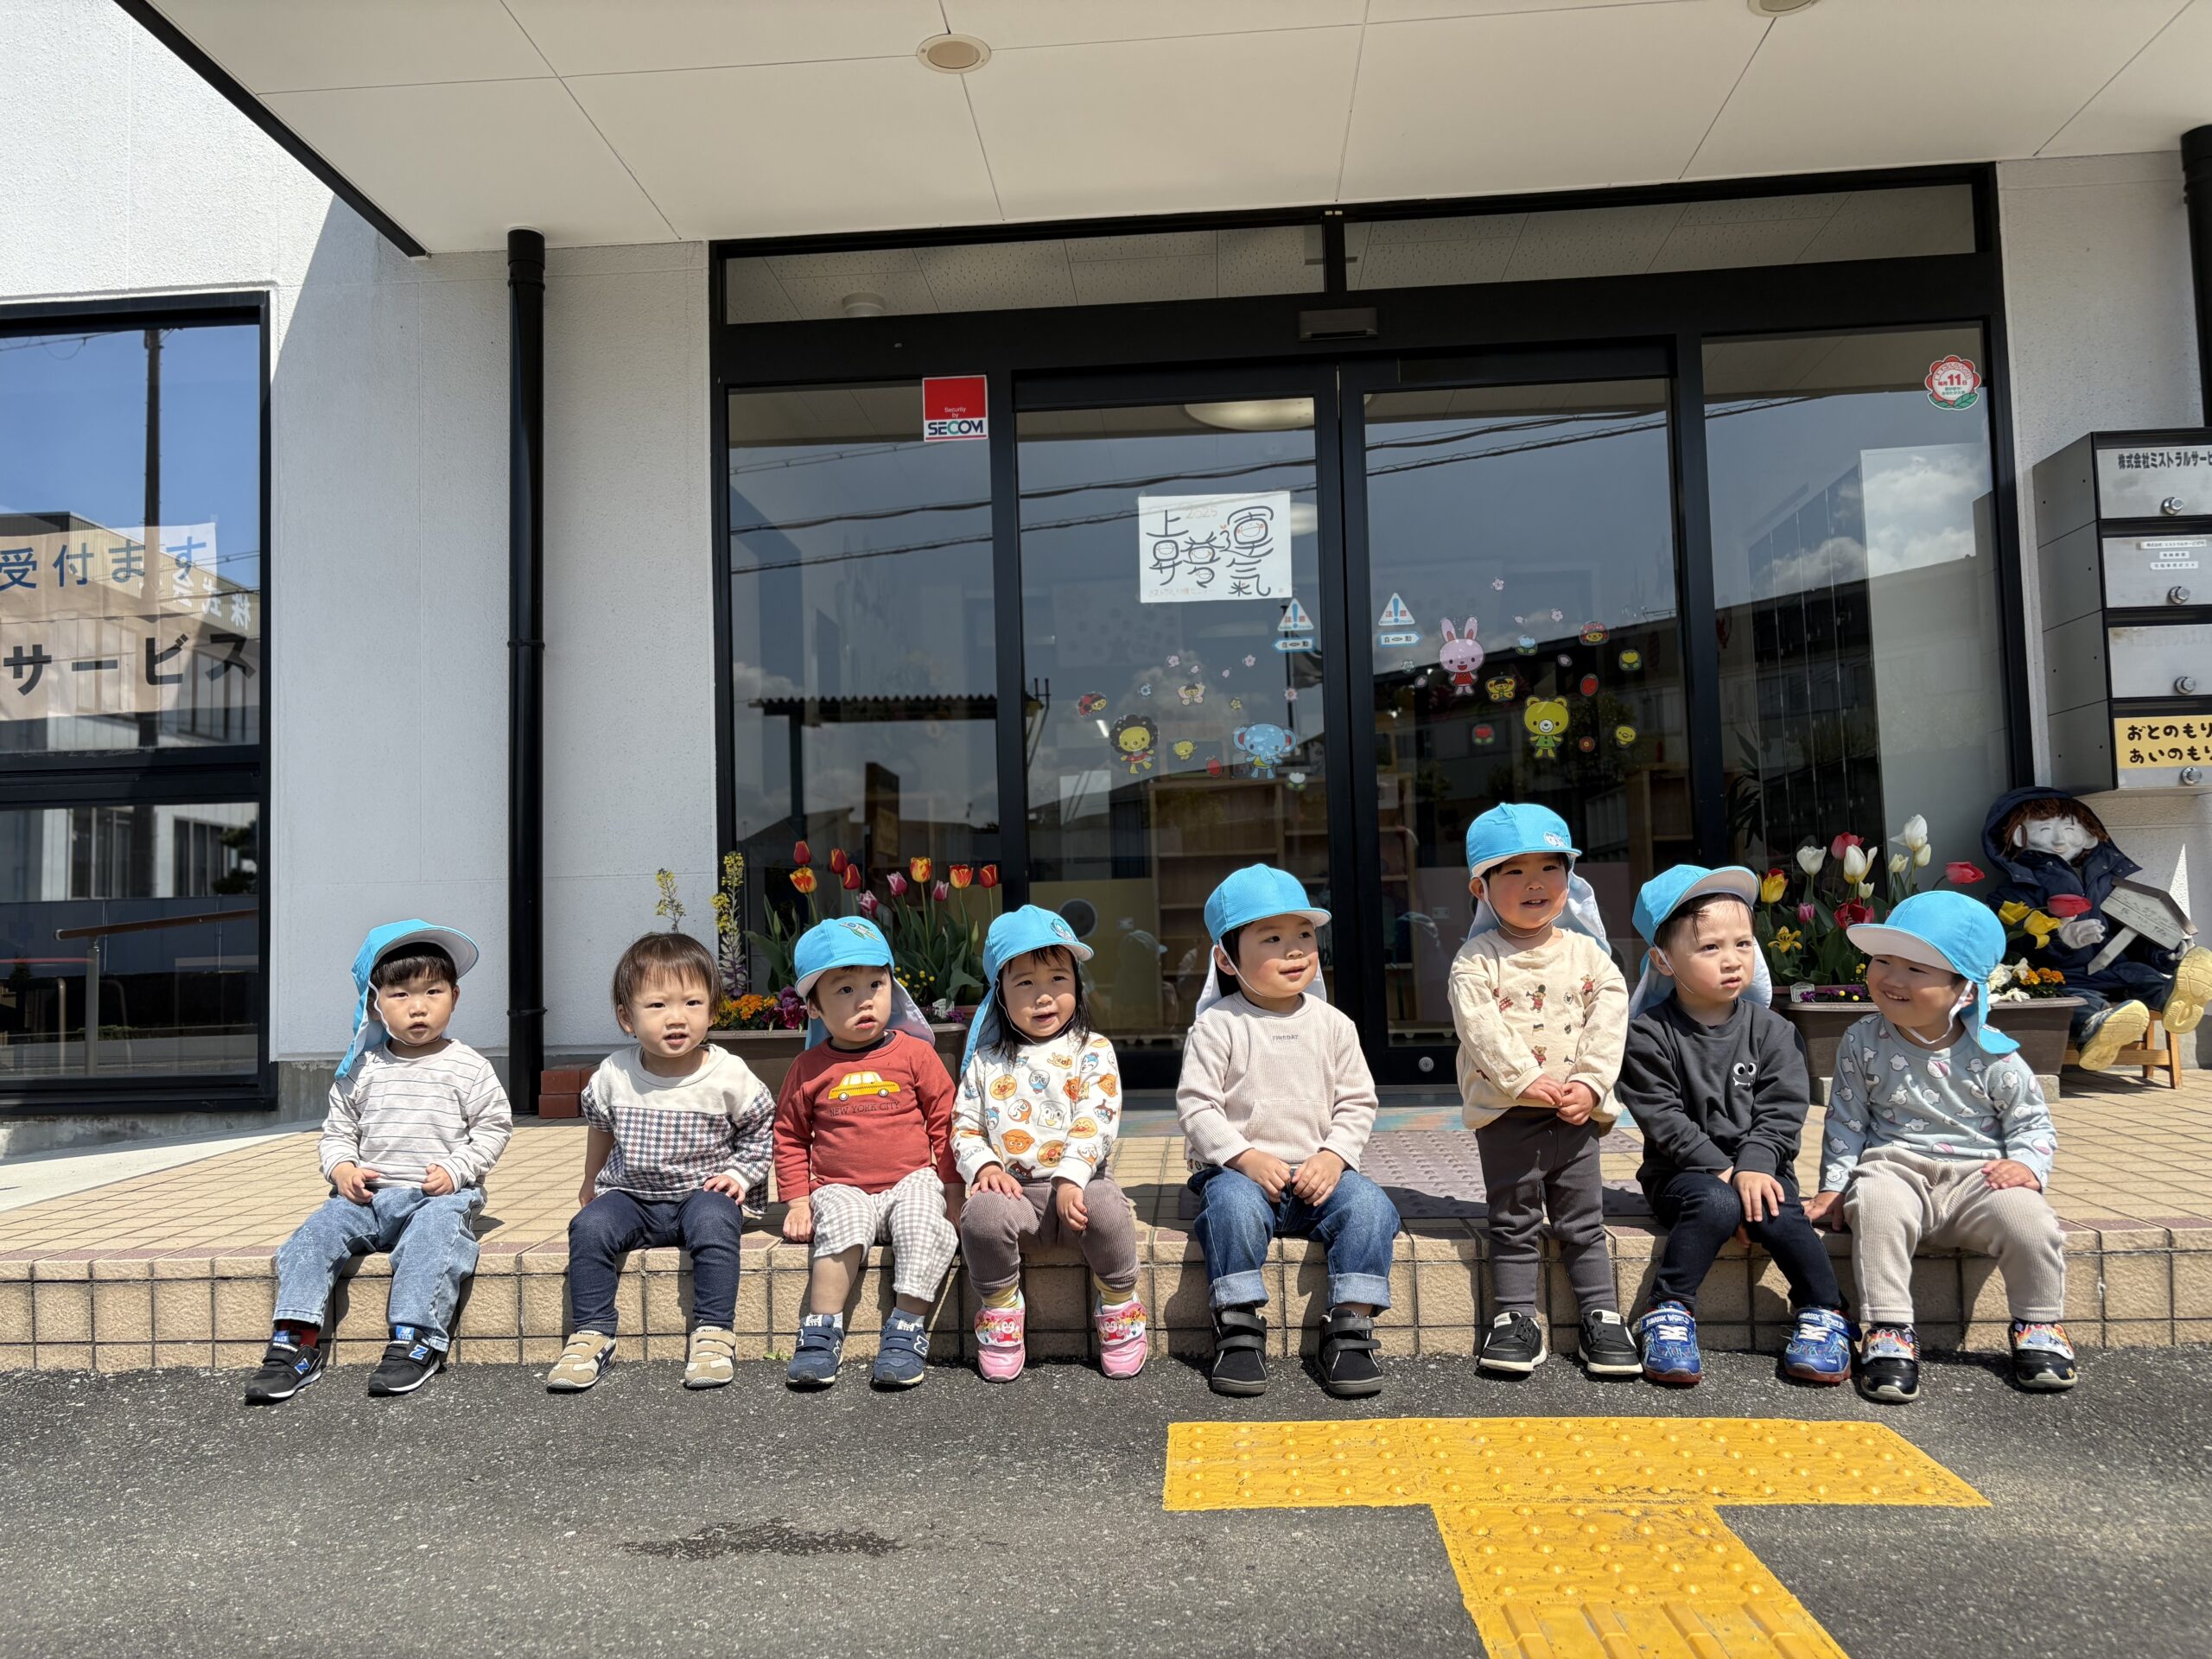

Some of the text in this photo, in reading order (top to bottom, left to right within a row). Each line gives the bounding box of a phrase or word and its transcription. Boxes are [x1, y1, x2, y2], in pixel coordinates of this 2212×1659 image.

[928, 420, 984, 436] SECOM
[1186, 508, 1218, 520] 2025
[3, 633, 256, 696] サービス
[830, 1101, 899, 1117] NEW YORK CITY
[1667, 1314, 1690, 1325] WORLD
[409, 1344, 429, 1360] N
